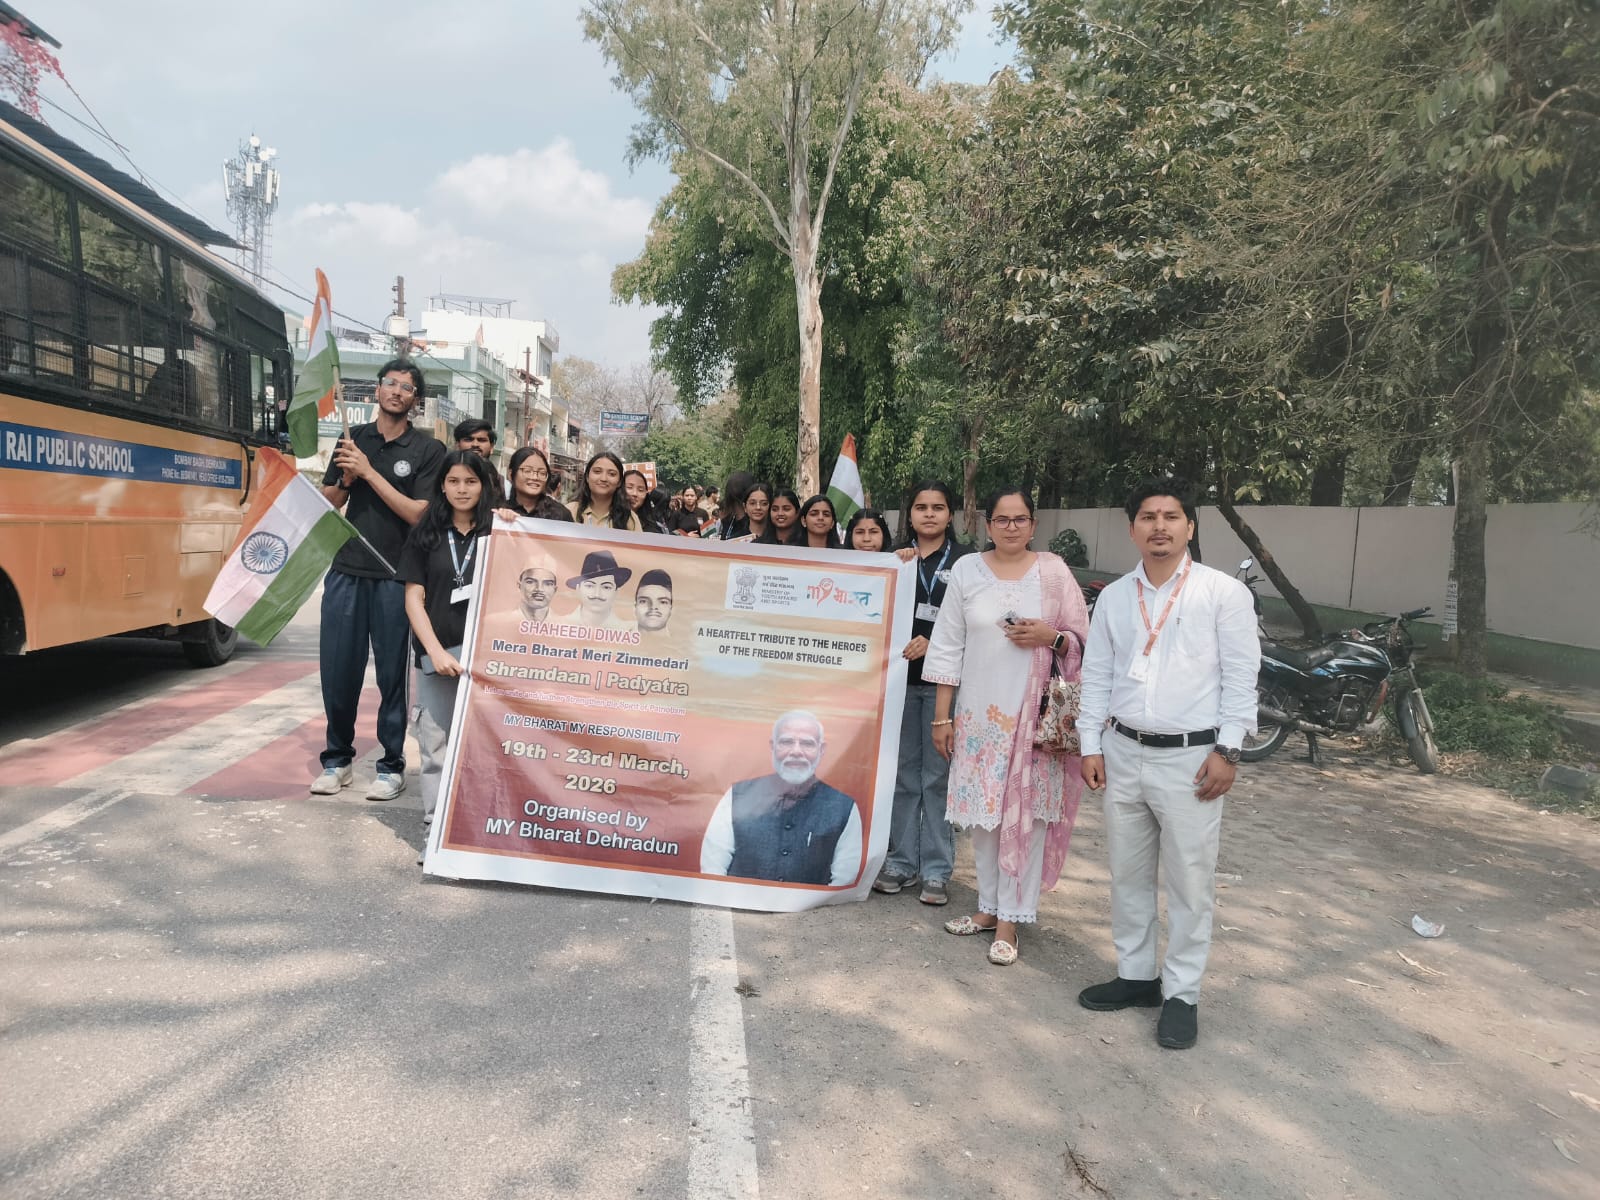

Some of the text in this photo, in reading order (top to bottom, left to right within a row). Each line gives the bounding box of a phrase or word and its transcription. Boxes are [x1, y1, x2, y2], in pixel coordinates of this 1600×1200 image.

[6, 431, 134, 473] RAI PUBLIC SCHOOL
[519, 621, 640, 644] SHAHEEDI DIWAS
[698, 627, 867, 652] A HEARTFELT TRIBUTE TO THE HEROES
[492, 640, 689, 670] Mera Bharat Meri Zimmedari
[719, 645, 842, 665] OF THE FREEDOM STRUGGLE
[485, 660, 590, 685] Shramdaan
[606, 672, 689, 696] Padyatra
[504, 714, 680, 743] MY BHARAT MY RESPONSIBILITY
[501, 740, 546, 760] 19th
[565, 748, 612, 768] 23rd
[619, 754, 689, 778] March,
[564, 774, 617, 794] 2026
[524, 800, 648, 832] Organised by
[486, 818, 679, 855] MY Bharat Dehradun
